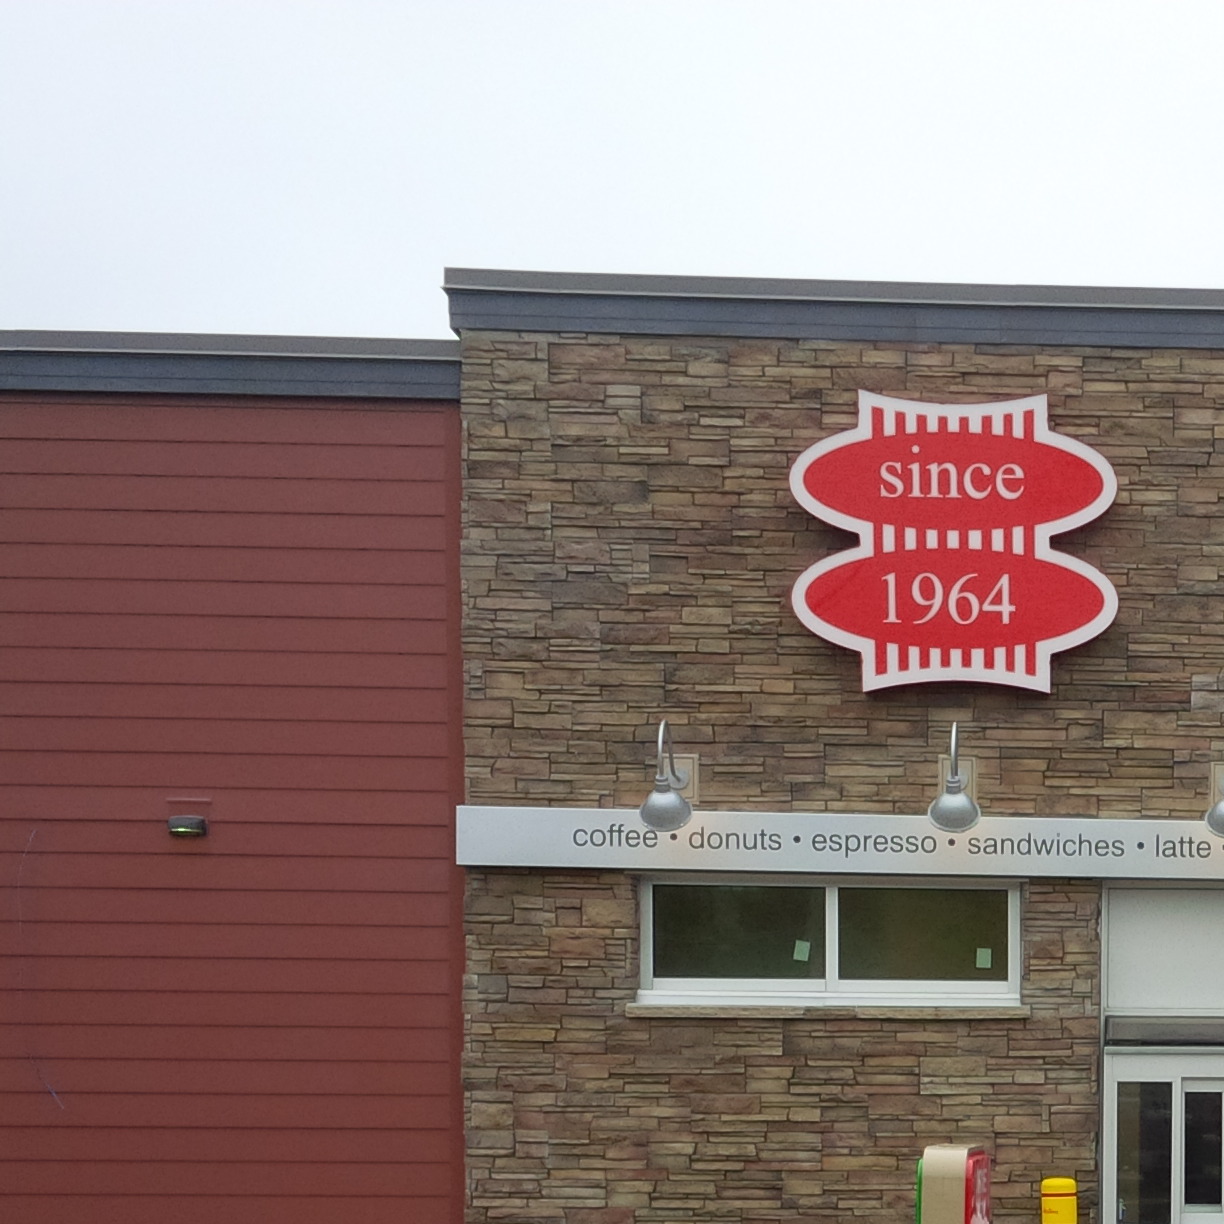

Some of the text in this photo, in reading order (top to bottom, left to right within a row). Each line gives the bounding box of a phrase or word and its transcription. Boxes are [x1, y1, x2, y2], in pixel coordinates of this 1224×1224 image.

[879, 444, 1025, 500] since
[880, 571, 1016, 625] 1964
[572, 823, 659, 848] coffee
[688, 826, 782, 851] donuts
[811, 831, 938, 858] espresso
[967, 832, 1125, 858] sandwiches
[1154, 833, 1212, 860] latte
